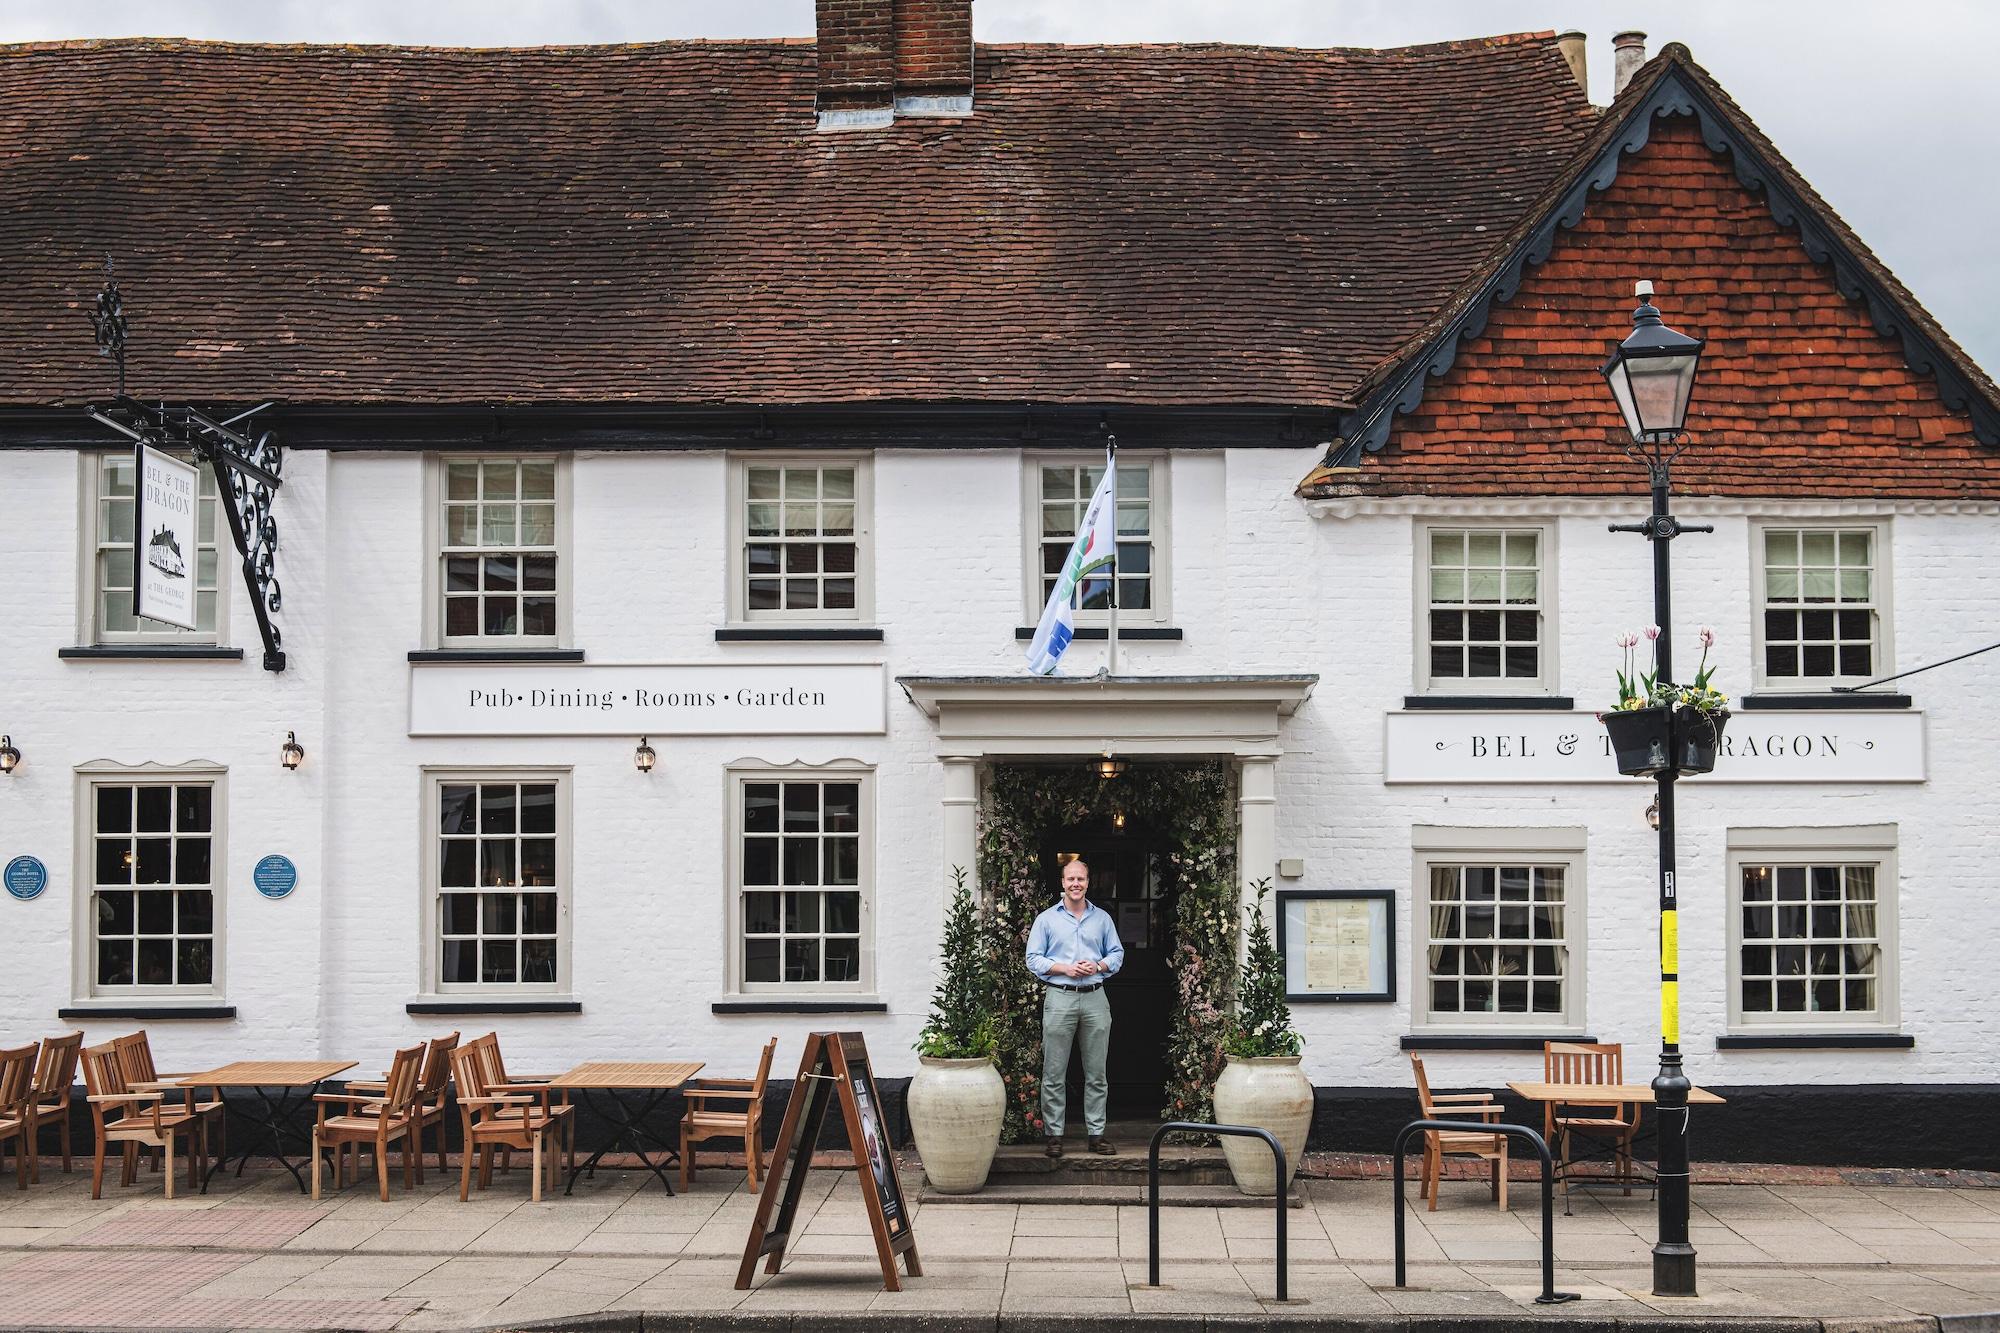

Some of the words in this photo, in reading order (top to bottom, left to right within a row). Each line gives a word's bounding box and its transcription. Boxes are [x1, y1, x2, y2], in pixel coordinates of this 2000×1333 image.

[146, 465, 162, 484] BEL
[165, 472, 173, 487] &
[174, 477, 190, 496] THE
[146, 483, 190, 515] DRAGON
[153, 582, 164, 594] THE
[164, 585, 186, 601] GEORGE
[470, 688, 513, 707] Pub
[531, 688, 613, 711] Dining
[635, 689, 715, 707] Rooms
[737, 687, 826, 706] Garden
[1472, 735, 1535, 757] BEL
[1556, 733, 1579, 756] &
[1717, 734, 1839, 757] RAGON
